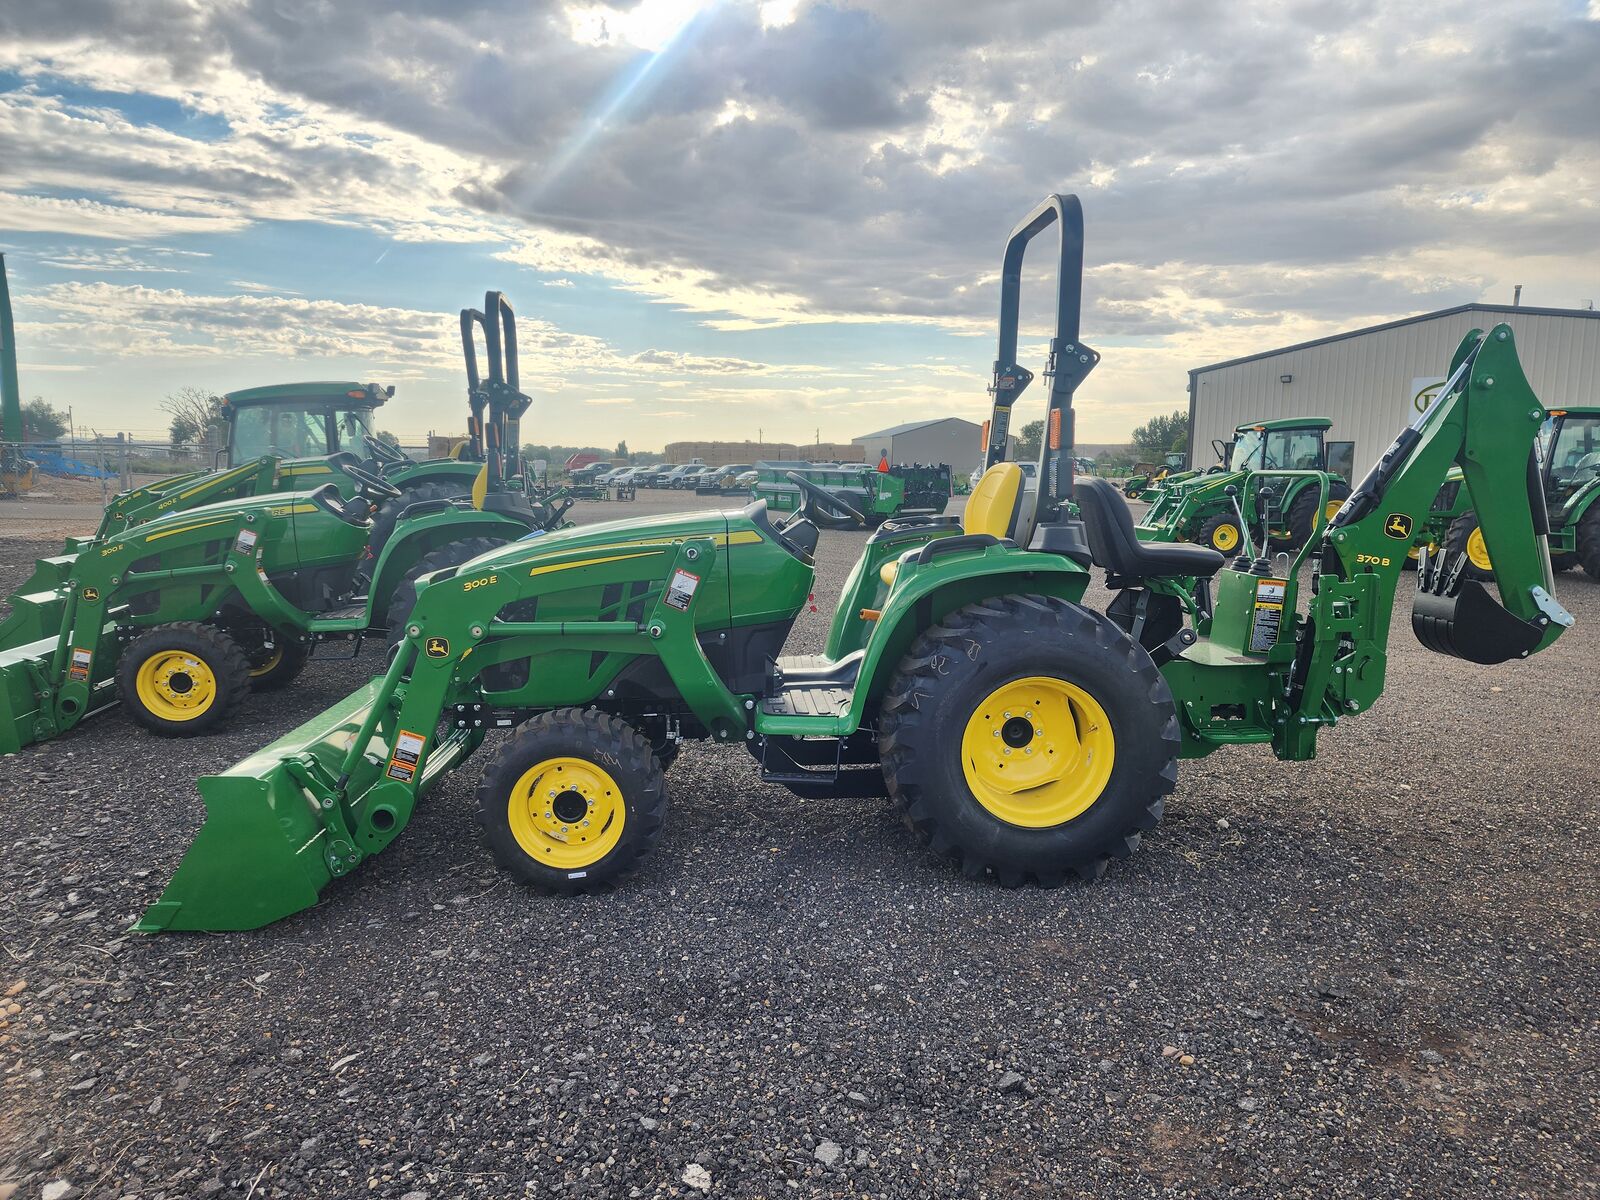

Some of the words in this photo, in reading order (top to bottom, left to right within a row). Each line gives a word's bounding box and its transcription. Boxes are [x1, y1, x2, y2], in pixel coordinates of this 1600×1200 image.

[158, 500, 172, 510] 400
[101, 546, 118, 557] 300
[1356, 554, 1380, 565] 370
[1381, 557, 1391, 567] B
[463, 578, 488, 592] 300
[489, 575, 498, 584] E
